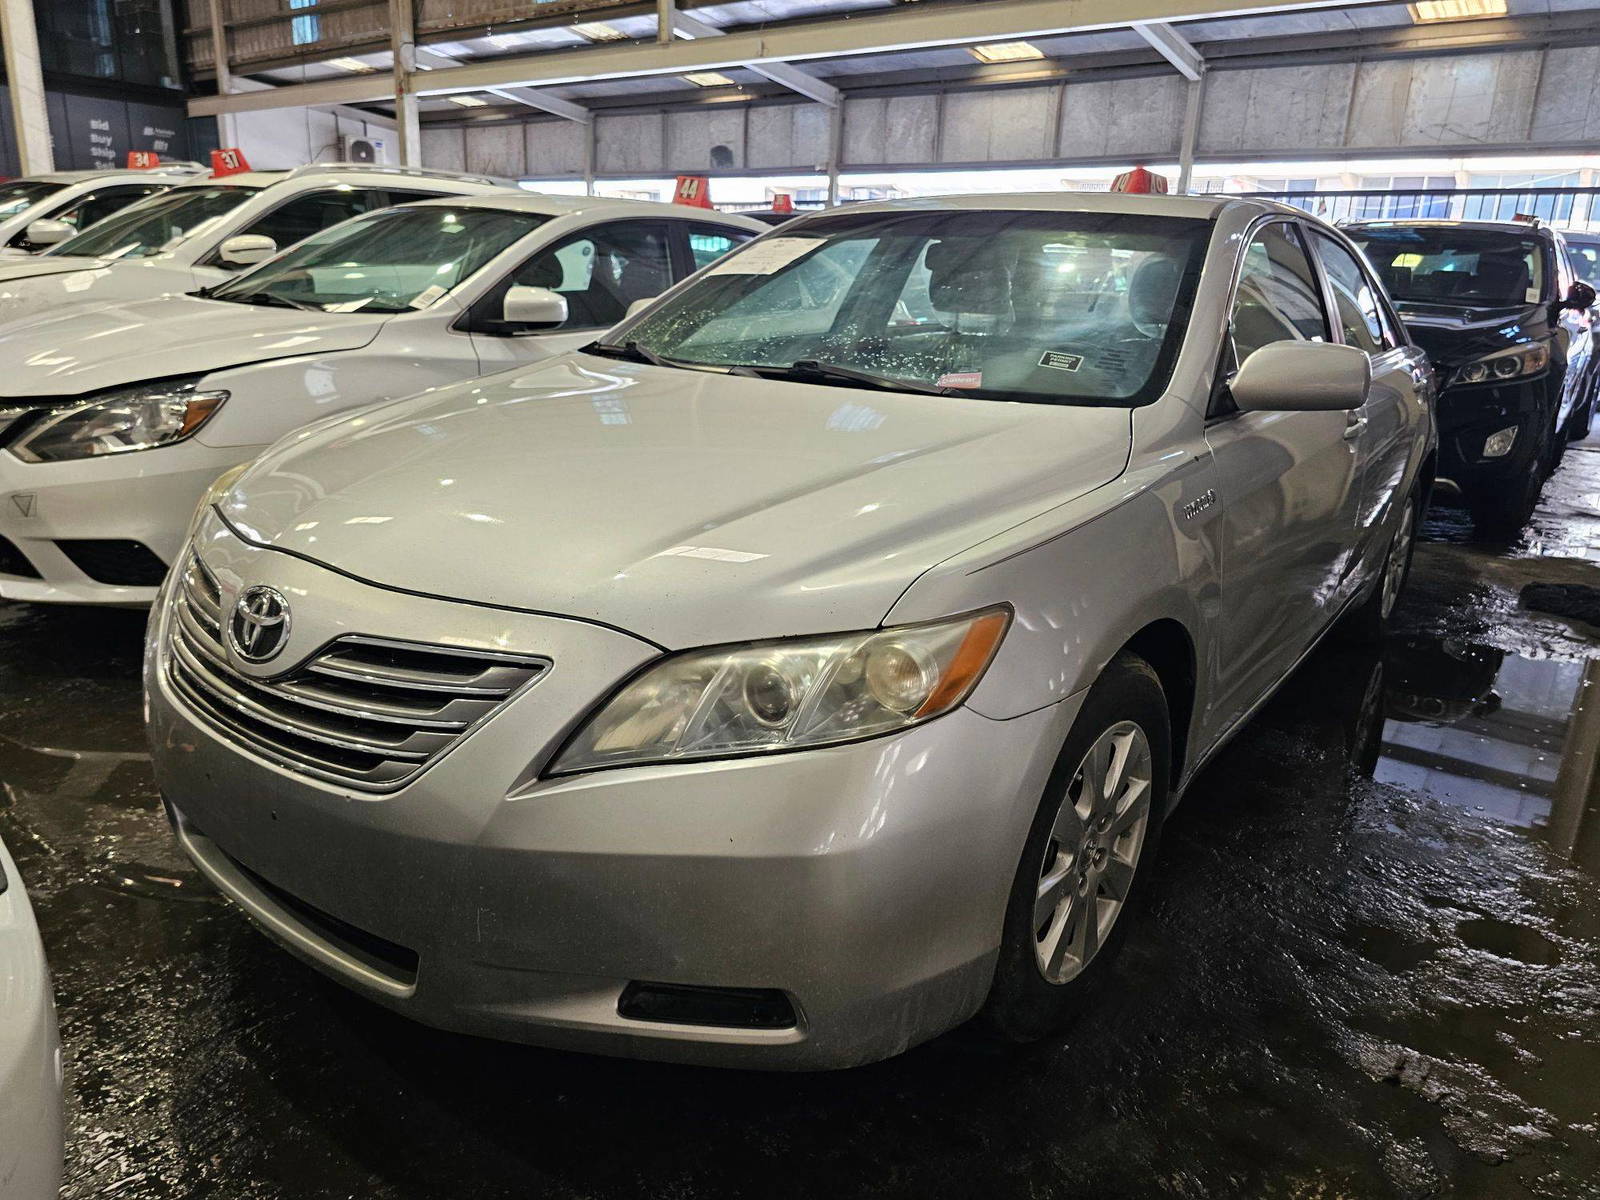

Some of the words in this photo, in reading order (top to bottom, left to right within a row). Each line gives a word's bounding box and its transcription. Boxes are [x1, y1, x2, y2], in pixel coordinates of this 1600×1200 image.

[90, 119, 110, 131] Bid
[90, 133, 113, 147] Buy
[90, 147, 117, 160] Ship
[135, 152, 150, 167] 34
[680, 179, 699, 200] 44
